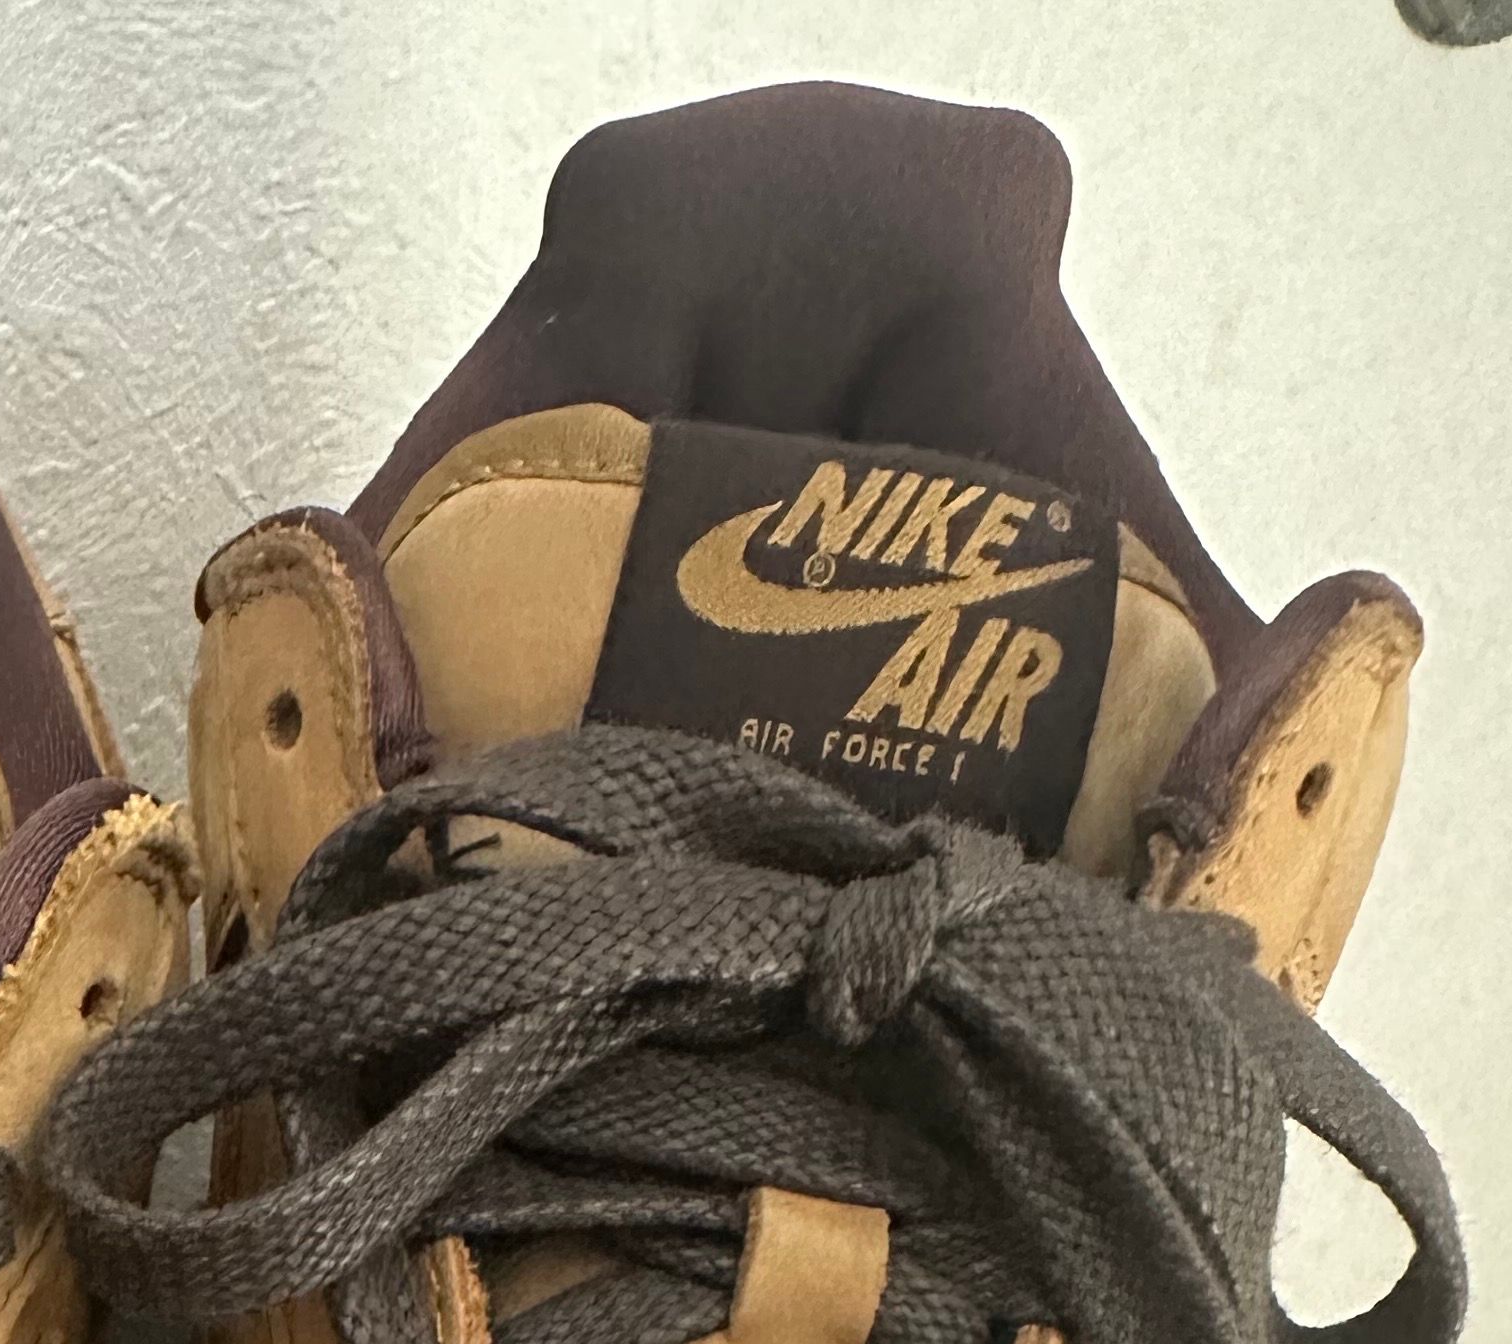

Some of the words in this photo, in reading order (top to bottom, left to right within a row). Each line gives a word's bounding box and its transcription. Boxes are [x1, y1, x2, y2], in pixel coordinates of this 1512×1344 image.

[767, 461, 1036, 577] NIKE
[844, 608, 1064, 753] AIR
[739, 718, 794, 755] AIR
[821, 731, 937, 776] FORCE
